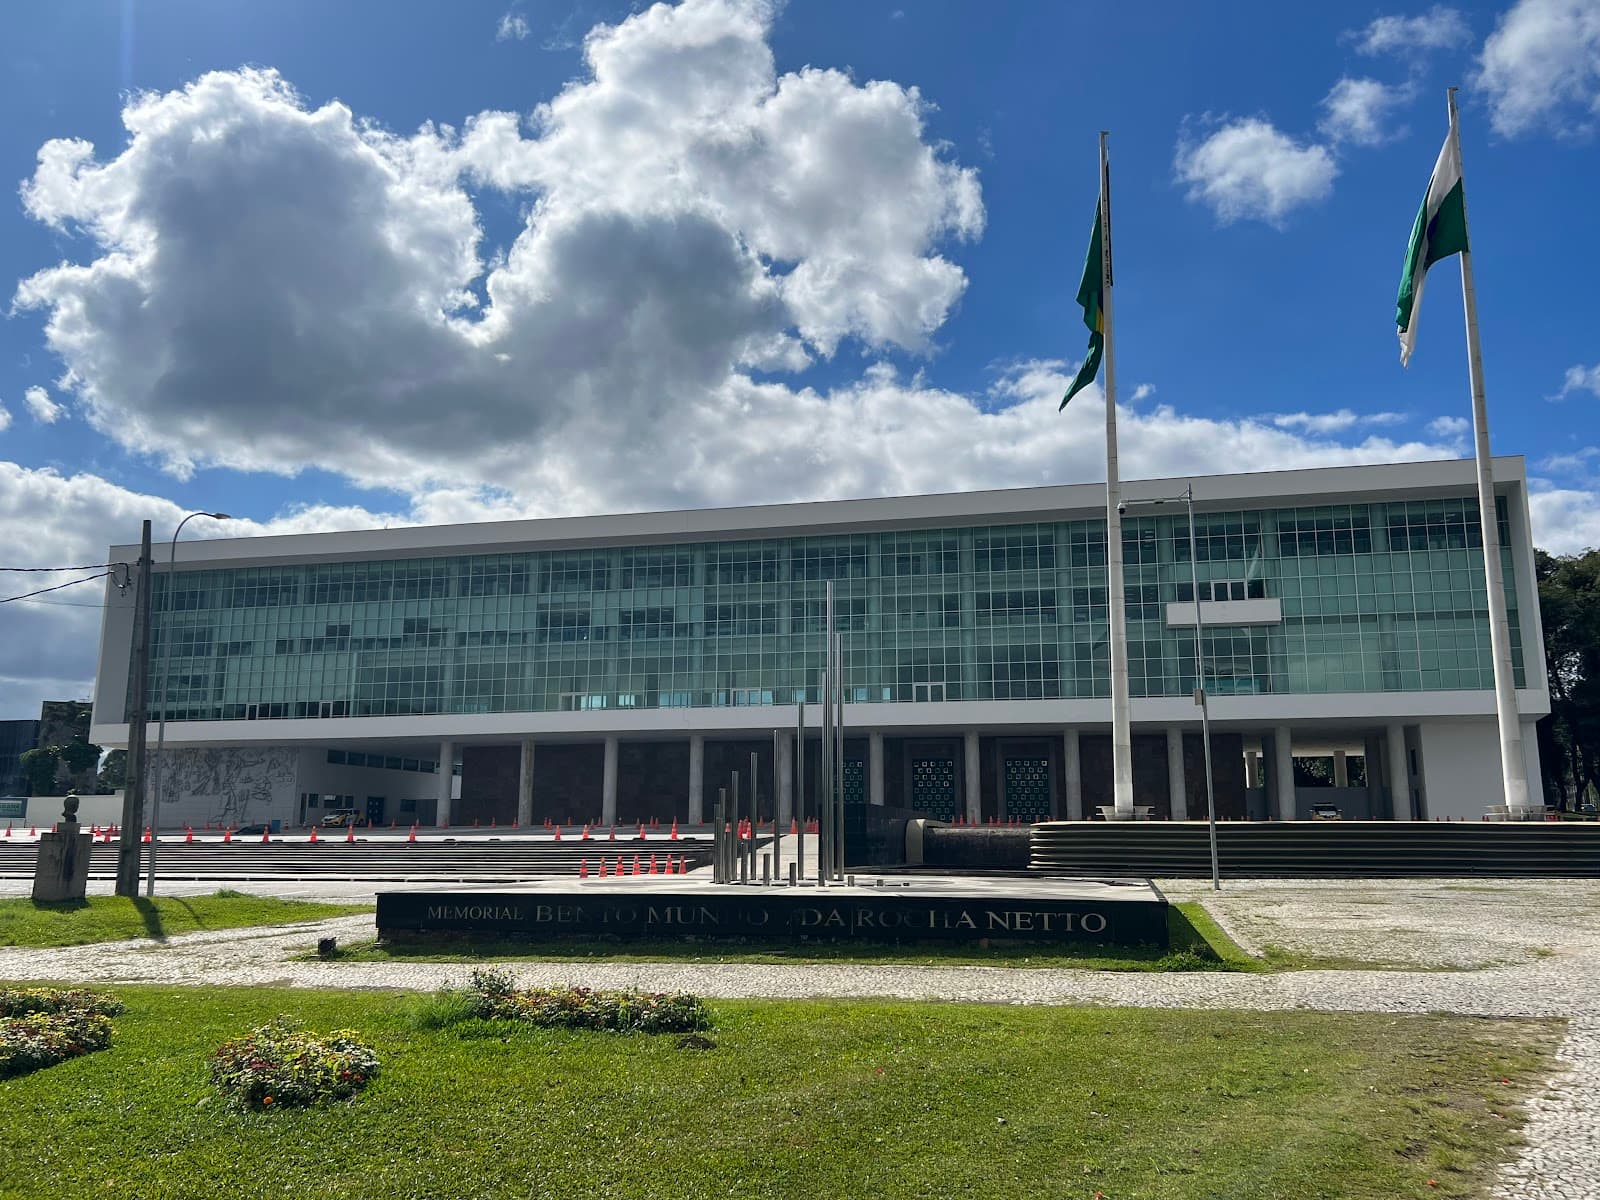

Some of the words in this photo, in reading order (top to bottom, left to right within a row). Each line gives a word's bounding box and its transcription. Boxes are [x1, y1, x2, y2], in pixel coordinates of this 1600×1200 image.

[427, 906, 524, 920] MEMORIAL
[647, 905, 792, 925] MUNO
[799, 908, 846, 926] DA
[984, 911, 1107, 933] NETTO
